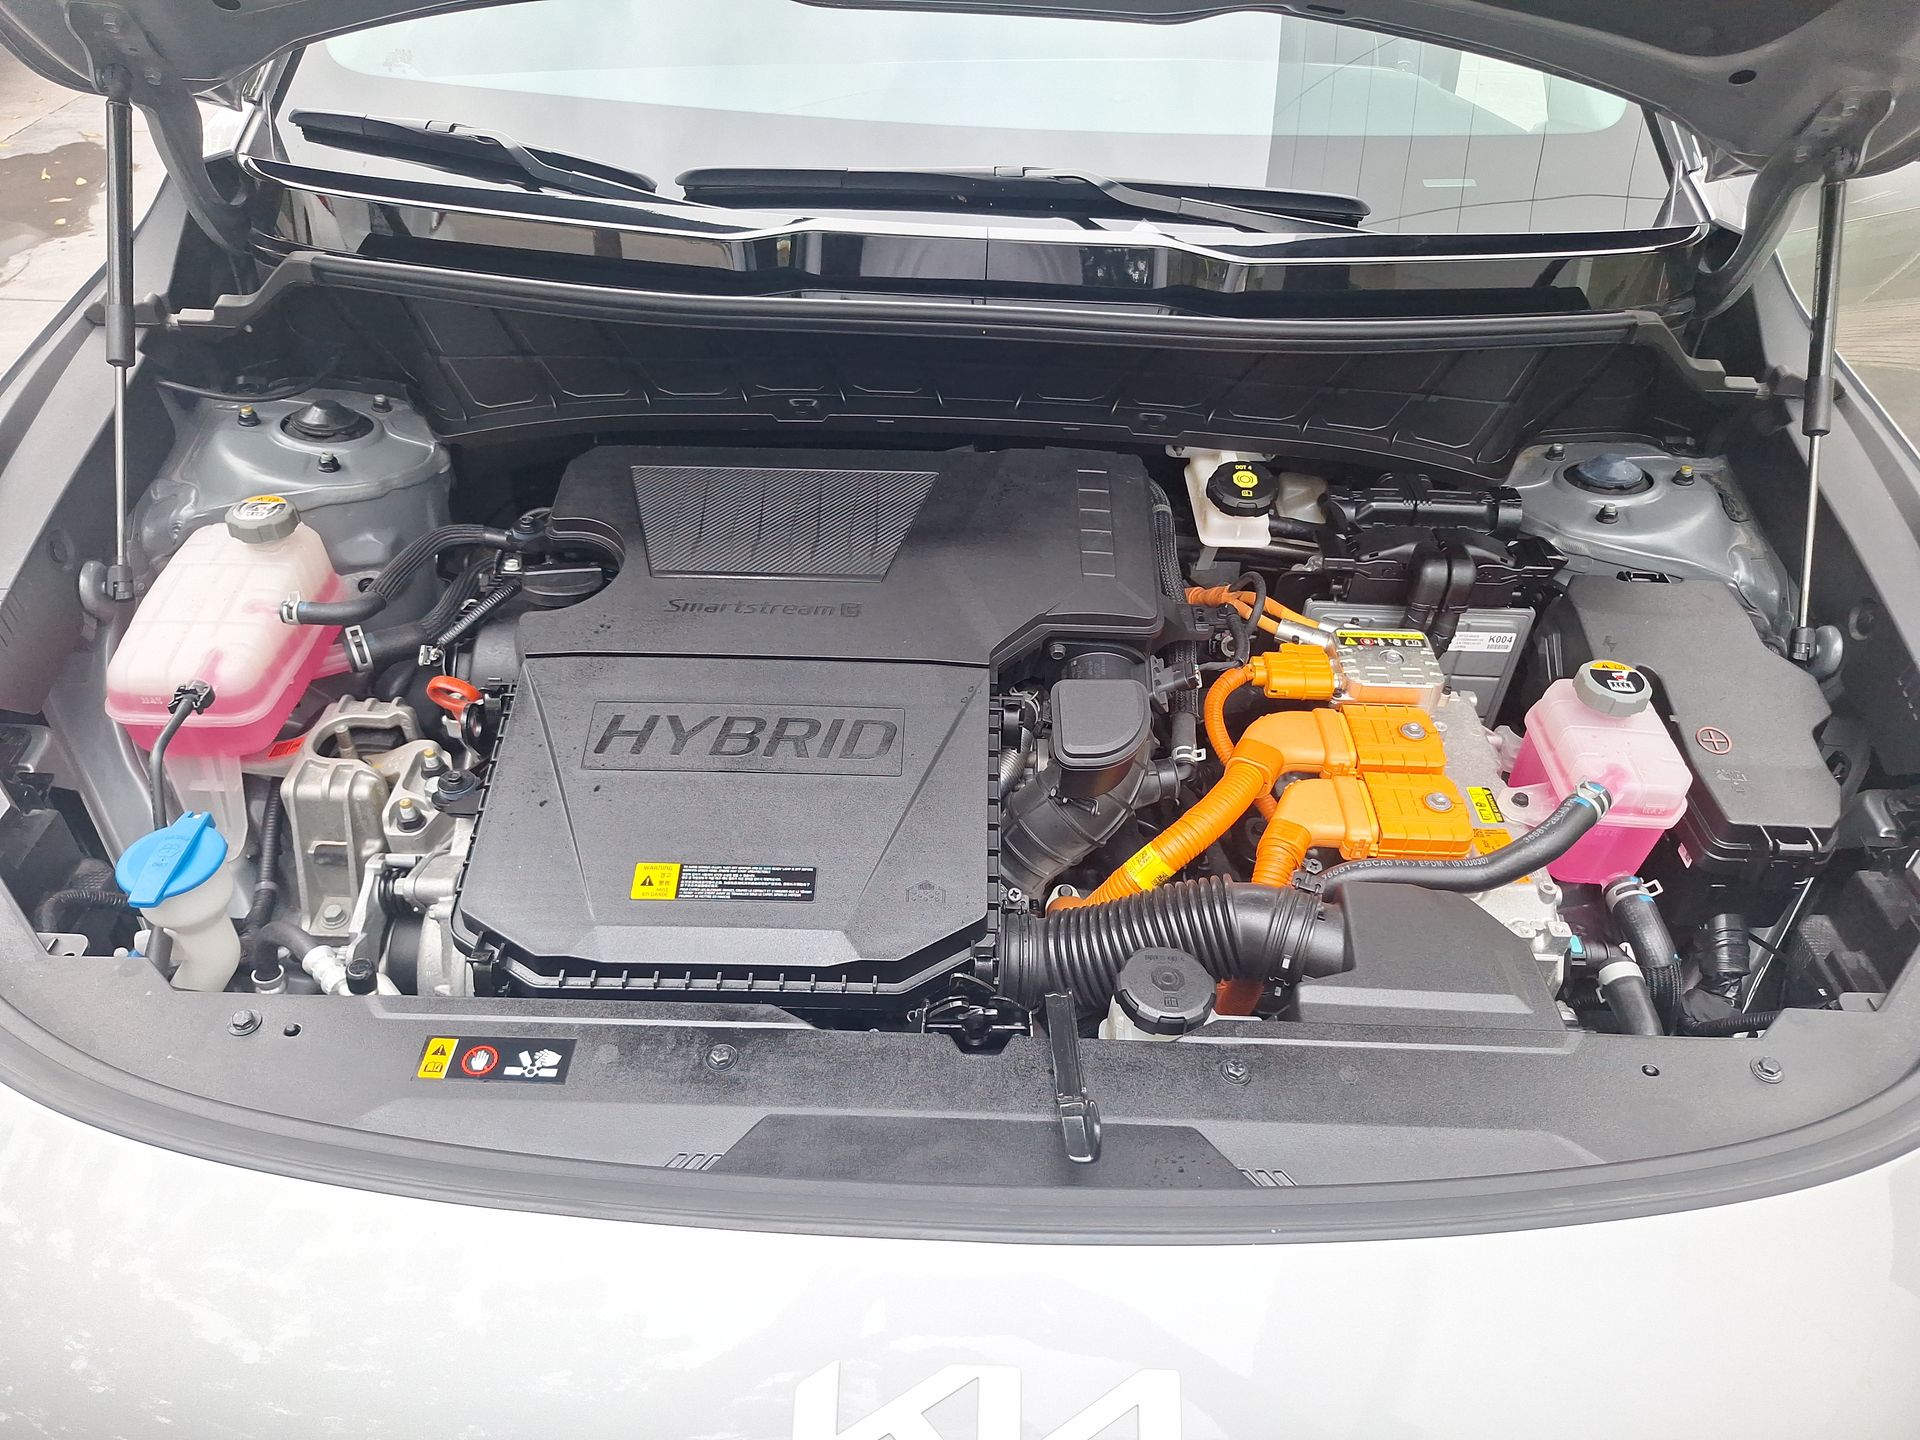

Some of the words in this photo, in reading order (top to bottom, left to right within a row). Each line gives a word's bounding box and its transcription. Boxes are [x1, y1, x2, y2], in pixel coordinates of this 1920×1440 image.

[663, 598, 834, 616] Smartstream
[1488, 635, 1513, 644] K004
[593, 714, 898, 760] HYBRID
[1418, 860, 1444, 868] EPDM
